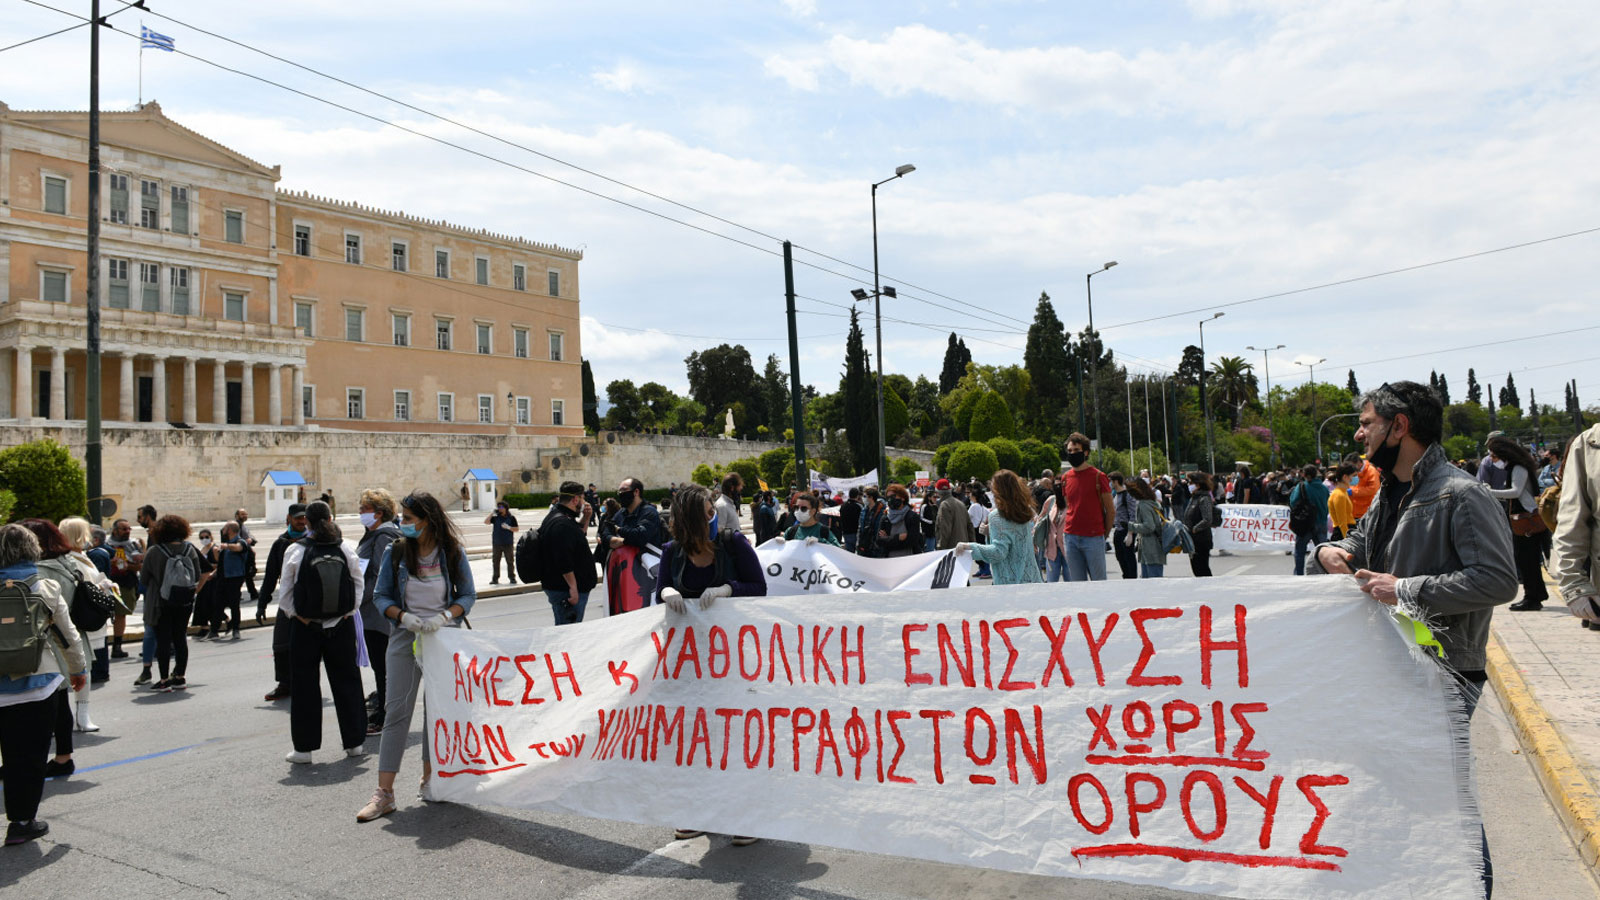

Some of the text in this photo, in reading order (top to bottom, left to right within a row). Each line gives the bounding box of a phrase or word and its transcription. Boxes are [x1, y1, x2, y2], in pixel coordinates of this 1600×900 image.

[790, 564, 866, 592] κρίκος
[1231, 530, 1258, 543] ΤΩΝ
[453, 652, 583, 708] ΑΜΕΣΗ
[902, 604, 1249, 692] ΕΝΙΣΧΥΣΗ
[434, 699, 1270, 786] ΟΛΩΝ των ΚΙΝΗΜΑΤΟΓΡΑΦΙΣΤΩΝ ΧΩΡΙΣ
[1067, 769, 1350, 858] ΟΡΟΥΣ
